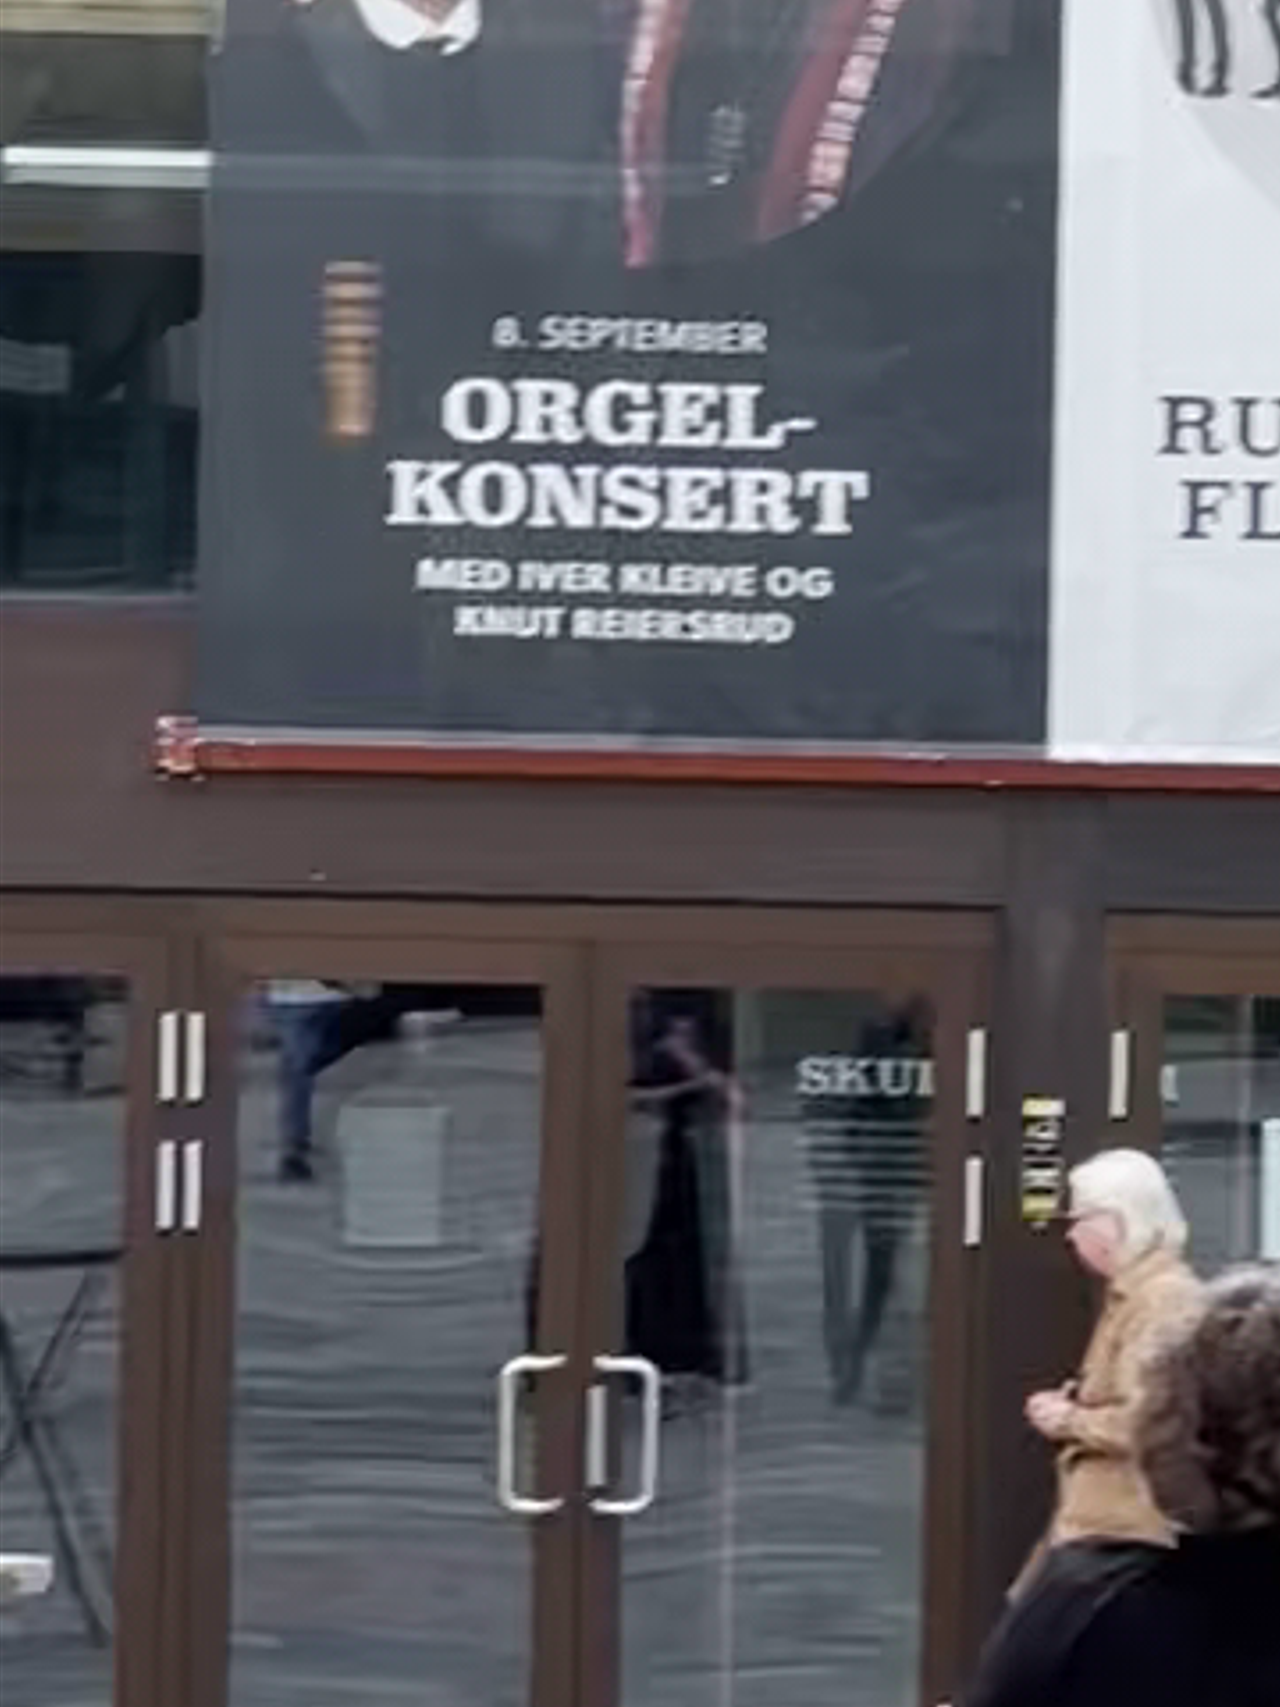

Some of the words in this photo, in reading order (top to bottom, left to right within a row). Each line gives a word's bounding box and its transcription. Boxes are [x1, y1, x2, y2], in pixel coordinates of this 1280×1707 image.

[537, 317, 768, 353] SEPTEMBER
[440, 377, 818, 449] ORGEL-
[384, 460, 871, 535] KONSERT
[415, 558, 511, 591] MED
[517, 562, 611, 592] IVER
[620, 564, 757, 596] KLEIVE
[764, 567, 835, 598] OG
[453, 606, 565, 637] KNUT
[571, 610, 794, 644] REIERSRUD
